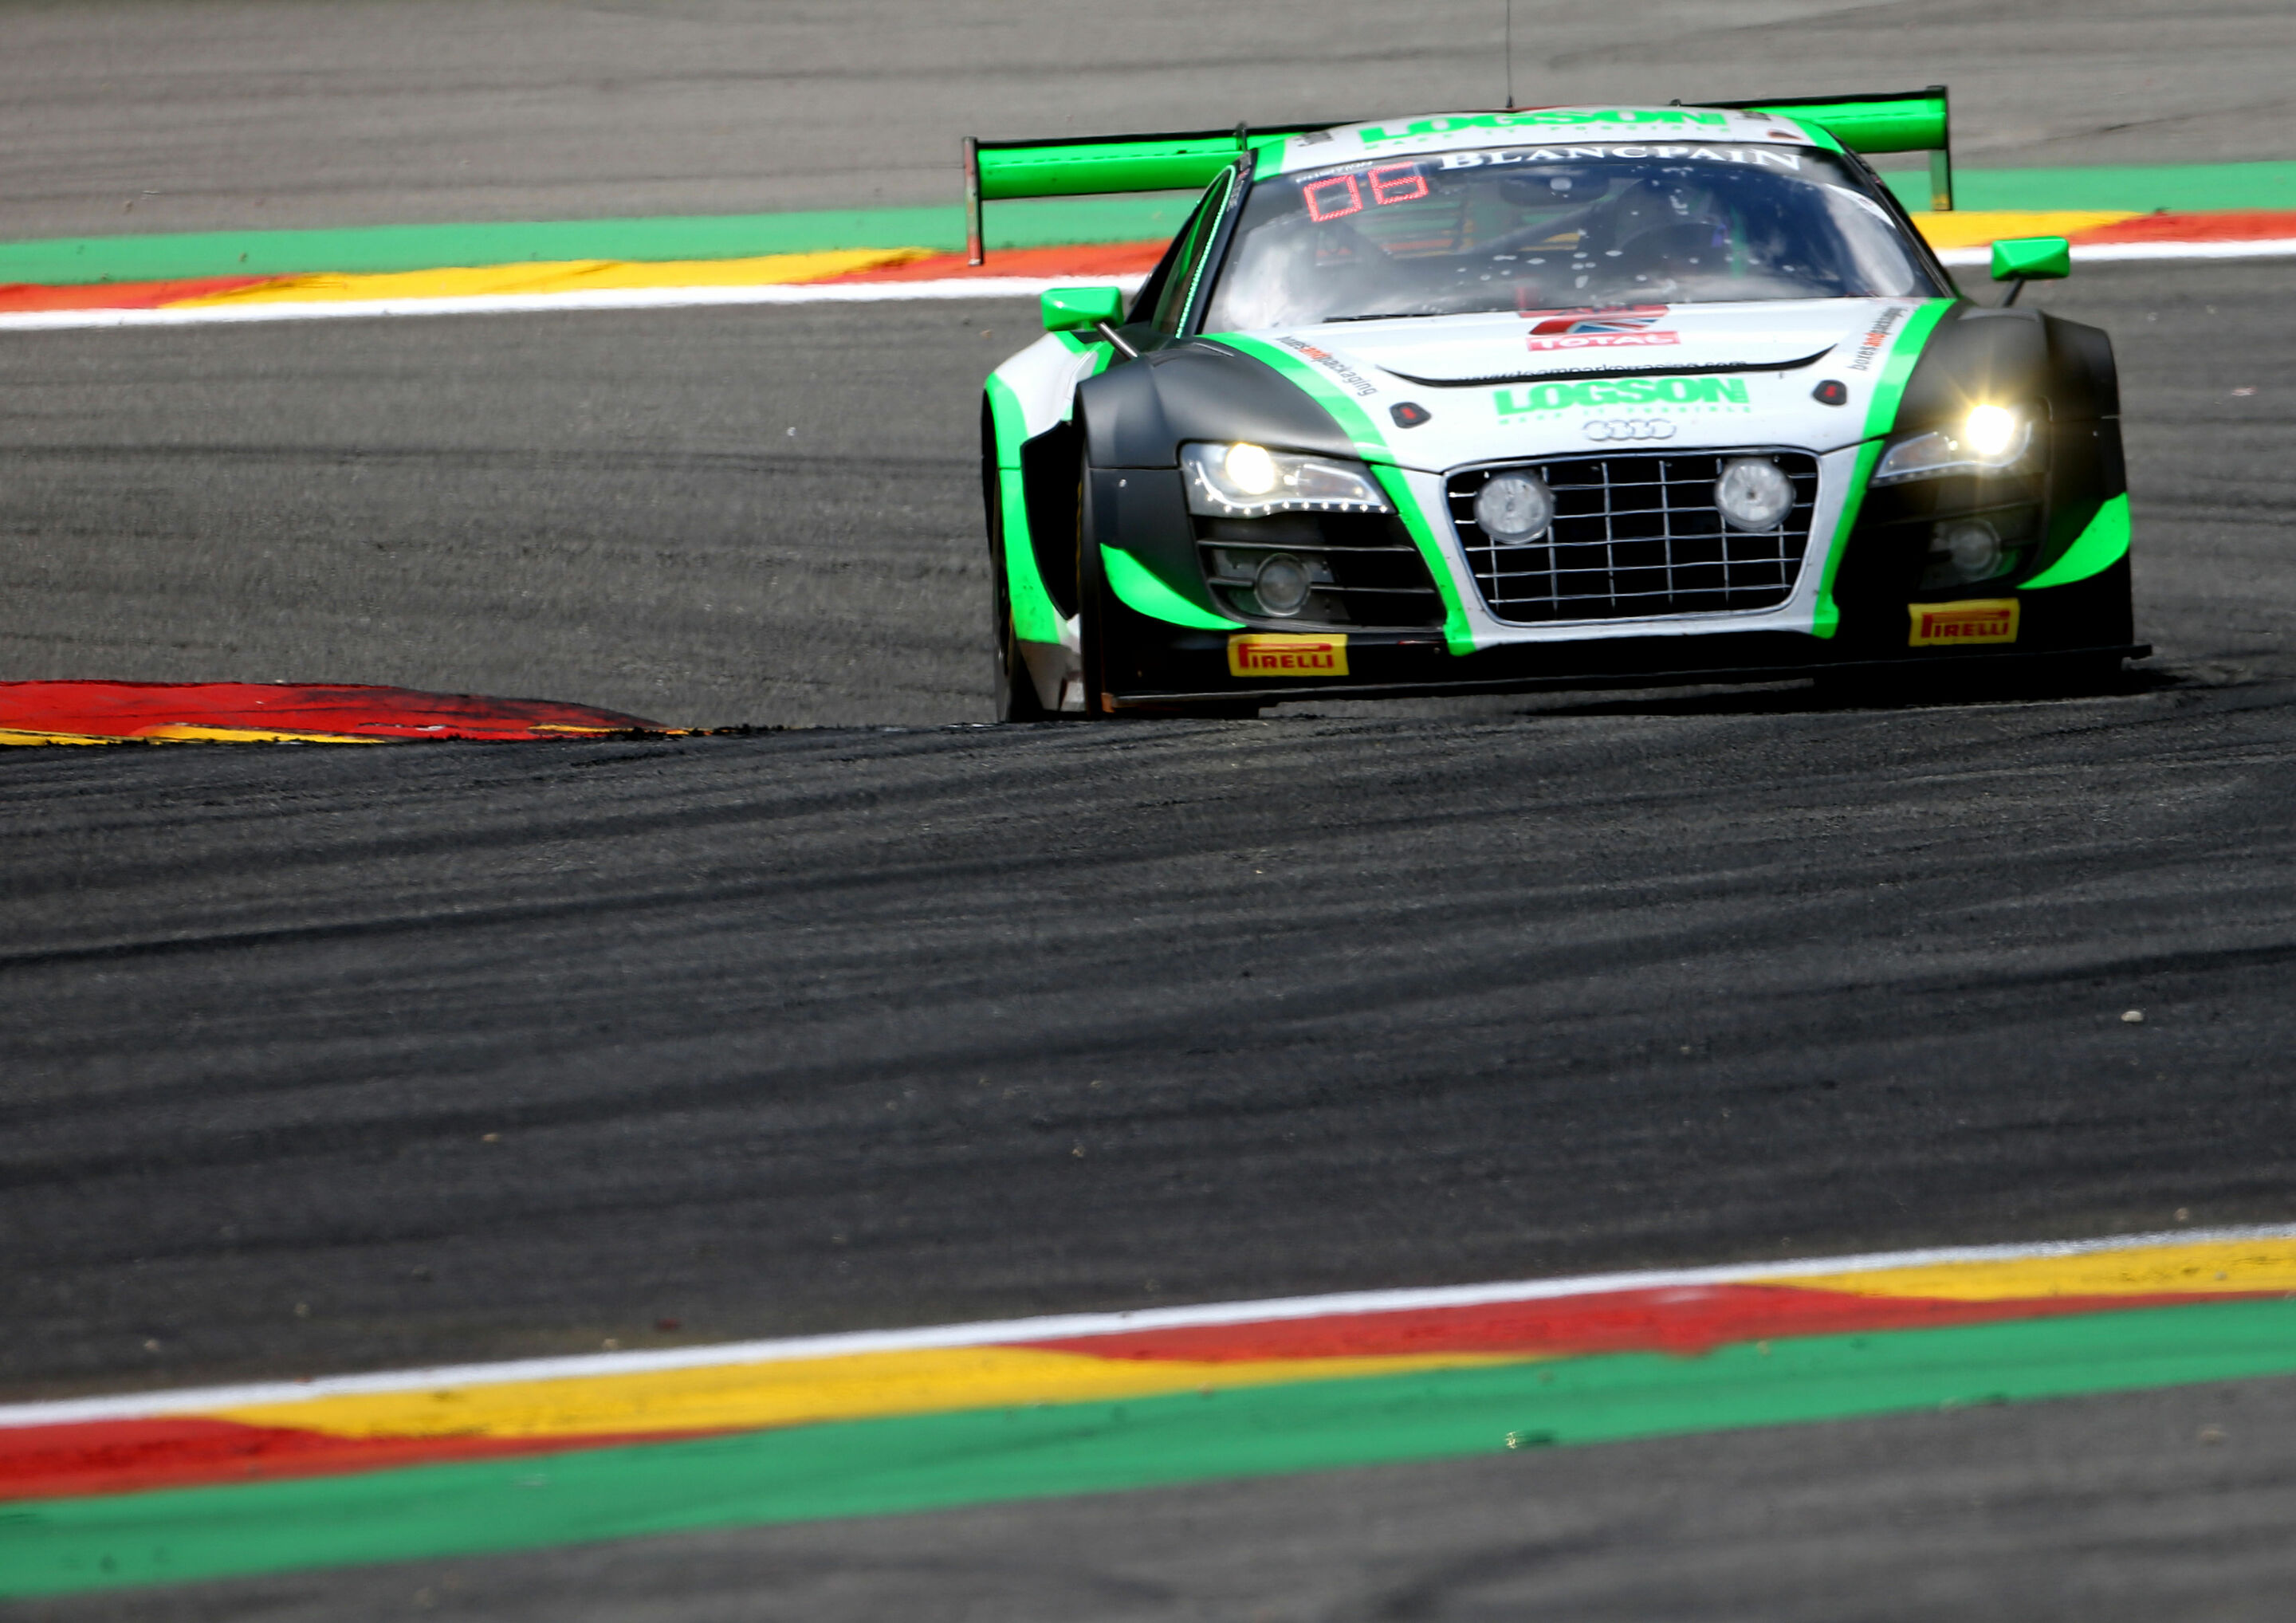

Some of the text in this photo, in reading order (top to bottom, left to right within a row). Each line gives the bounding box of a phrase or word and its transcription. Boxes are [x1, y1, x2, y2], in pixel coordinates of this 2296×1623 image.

[1358, 109, 1728, 143] LOGSON
[1438, 146, 1801, 171] BLANCPAIN
[1531, 333, 1675, 350] TOTAL
[1493, 377, 1750, 415] LOGSON
[1921, 608, 2011, 639] PIRELLI
[1238, 643, 1335, 669] PIRELLI
